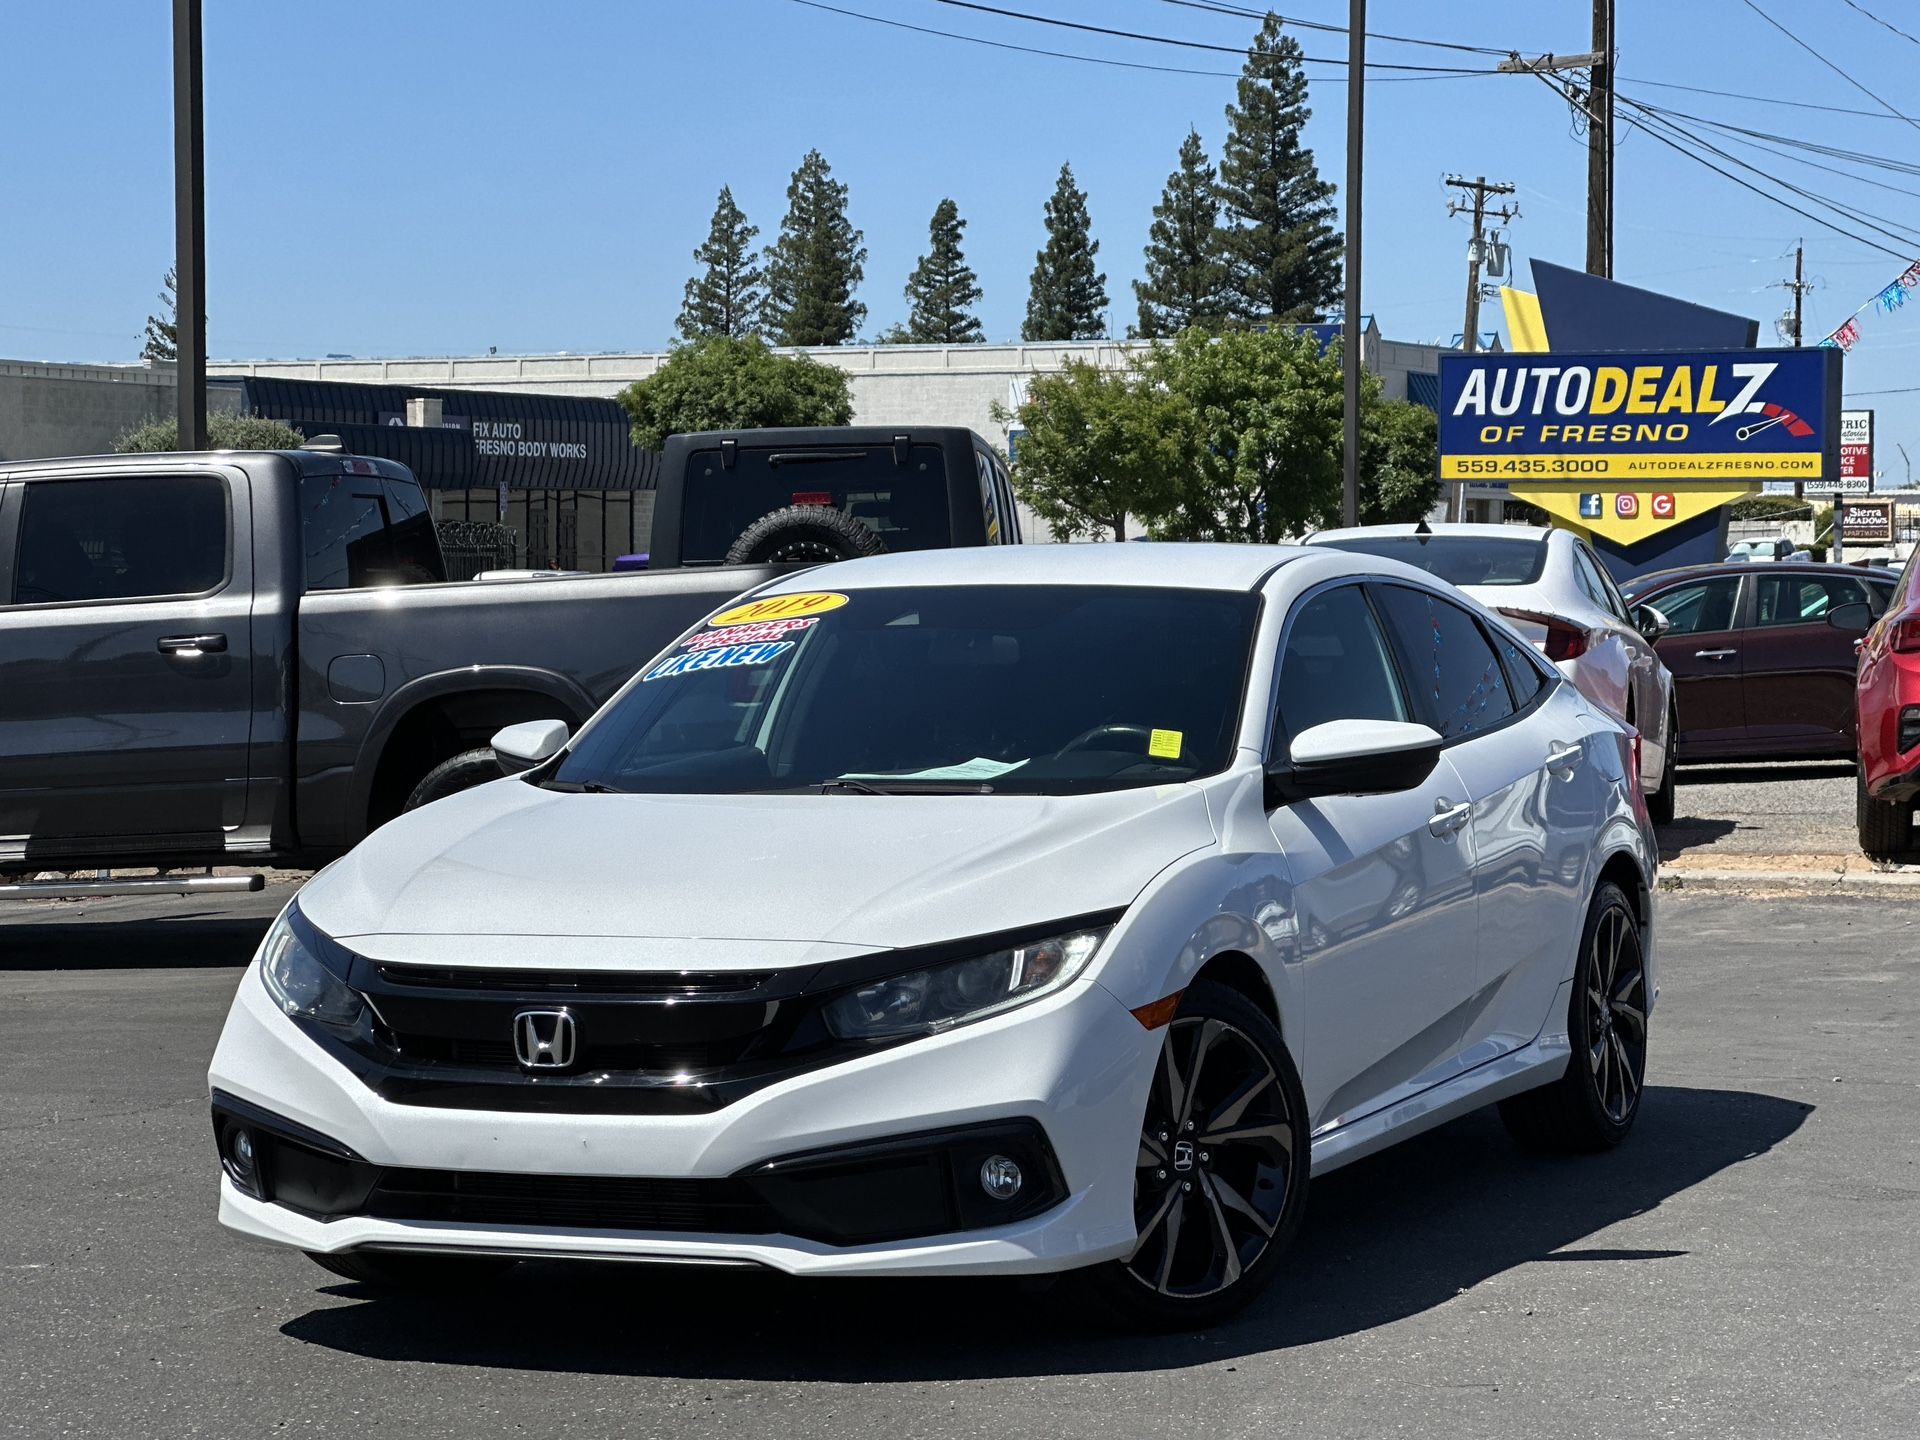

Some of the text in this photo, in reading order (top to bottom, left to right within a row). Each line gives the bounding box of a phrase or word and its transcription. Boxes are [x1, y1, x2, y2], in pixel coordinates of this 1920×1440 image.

[1452, 362, 1779, 427] AUTODEALZ
[473, 422, 522, 439] FIX AUTO
[1480, 424, 1689, 443] OF FRESNO
[475, 439, 587, 459] FRESNO BODY WORKS
[1457, 459, 1814, 474] 559.435.3000 AUTODEALZFRESNO.COM
[1843, 516, 1888, 525] MEADOWS
[1849, 507, 1882, 517] Sierra
[1843, 529, 1888, 537] APARTMENTS
[726, 595, 831, 622] 2019
[686, 619, 816, 644] MANAGERS
[692, 630, 783, 650] SPECIAL
